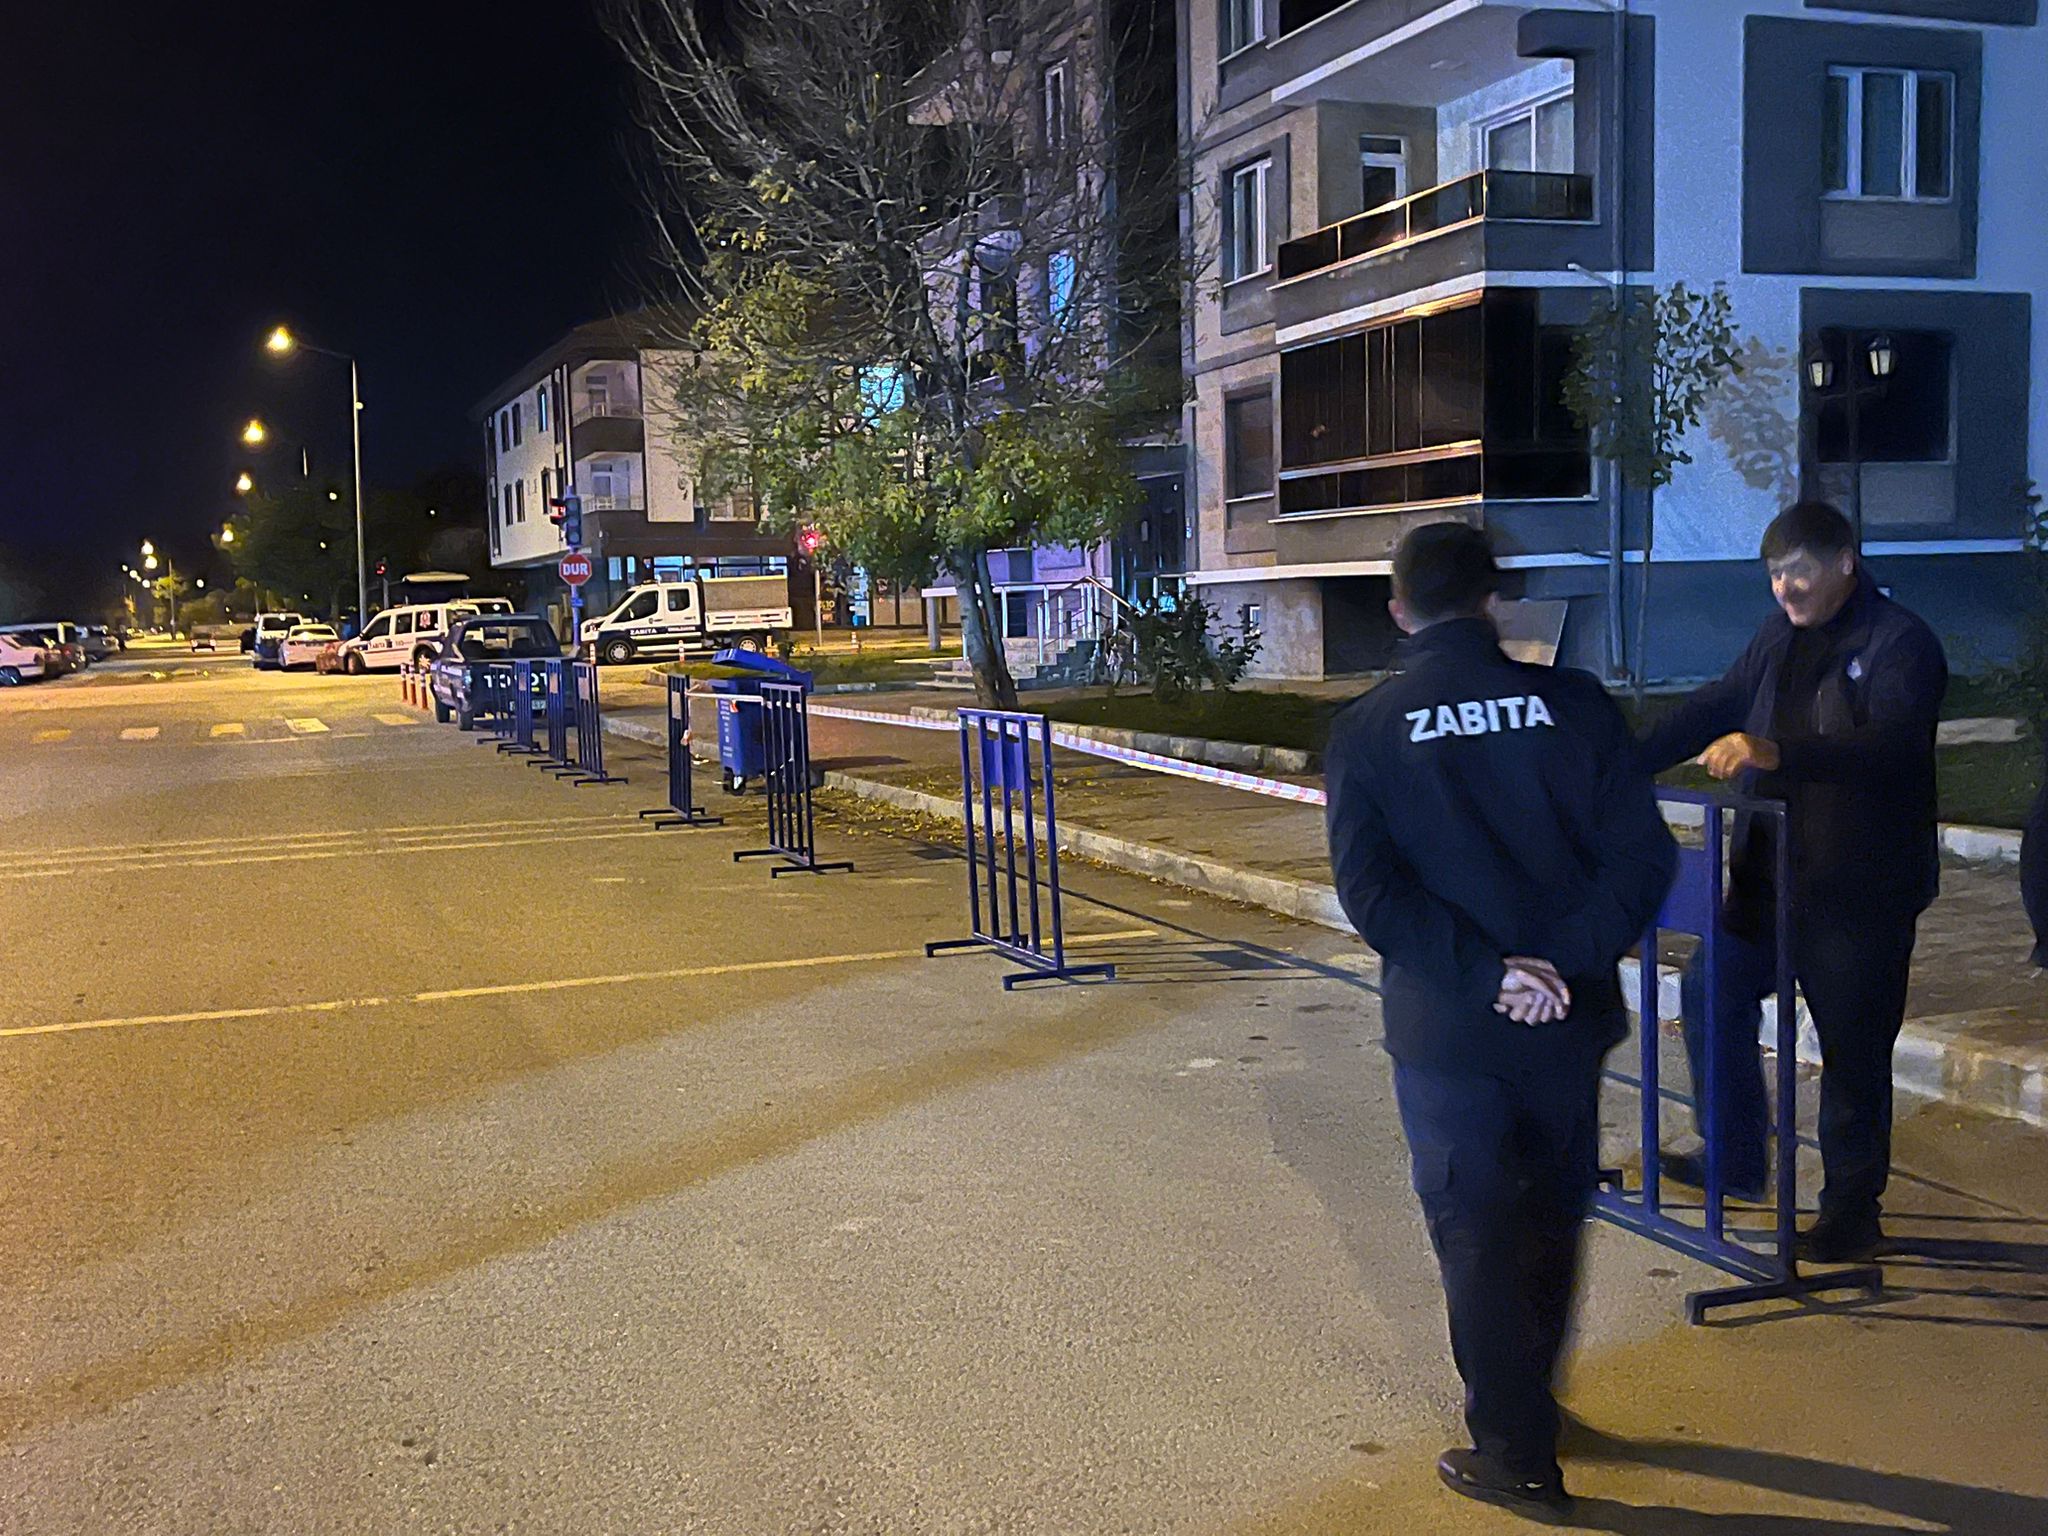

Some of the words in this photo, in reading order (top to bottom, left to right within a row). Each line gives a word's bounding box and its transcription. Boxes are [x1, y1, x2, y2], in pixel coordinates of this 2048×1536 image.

[562, 563, 588, 575] DUR
[484, 672, 562, 688] TOOT
[1405, 695, 1554, 742] ZABITA
